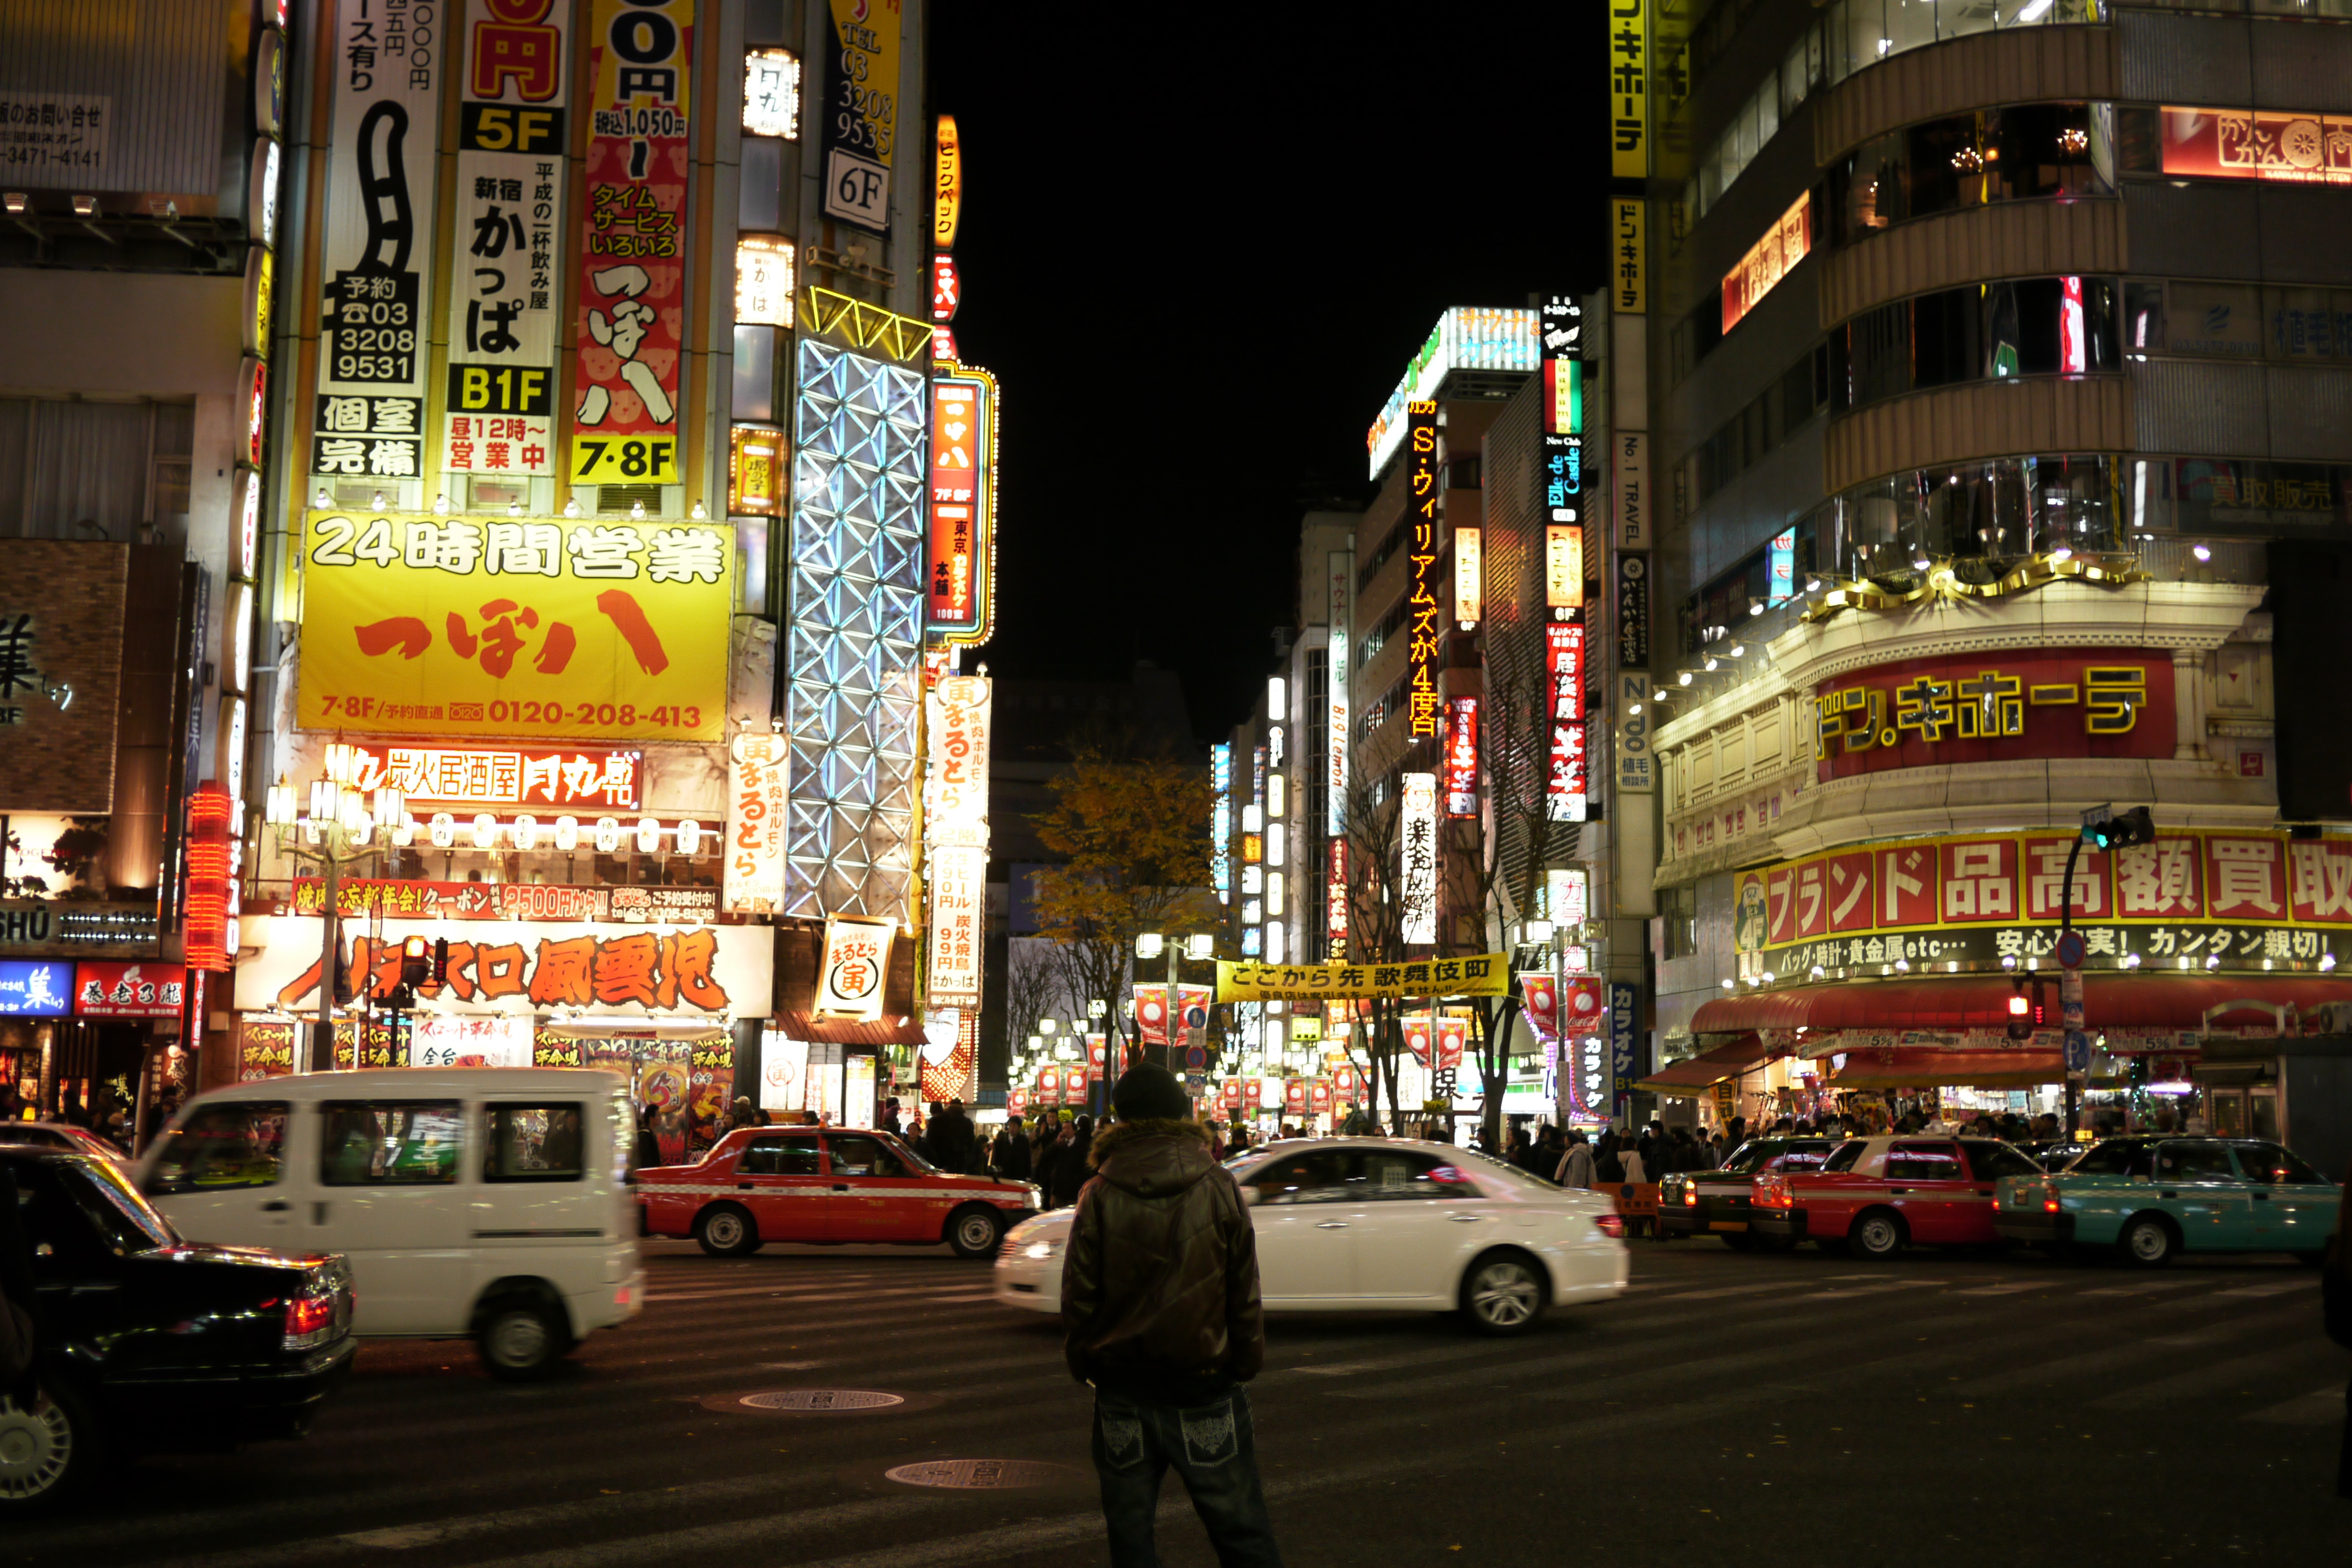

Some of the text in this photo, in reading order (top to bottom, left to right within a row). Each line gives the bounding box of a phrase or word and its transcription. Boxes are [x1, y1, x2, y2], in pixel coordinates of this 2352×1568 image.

[842, 23, 881, 53] TEL
[840, 48, 868, 81] 03
[838, 80, 892, 124] 3208
[475, 108, 553, 151] 5F
[594, 108, 685, 137] 税込1,050円
[837, 113, 892, 156] 9535
[475, 177, 522, 202] 新宿
[594, 185, 656, 209] タイム
[839, 168, 883, 210] 6F
[530, 162, 553, 309] 平成の一杯飲み屋
[593, 209, 679, 234] サービス
[591, 235, 677, 258] いろいろ
[343, 277, 397, 299] 予約
[371, 303, 409, 325] 03
[340, 329, 415, 352] 3208
[577, 264, 675, 426] つぼ八
[338, 357, 409, 381] 9531
[462, 368, 545, 411] B1F
[324, 397, 416, 433] 個室
[318, 439, 416, 476] 完備
[450, 443, 545, 470] 営業中
[1624, 481, 1640, 545] TRAVEL
[312, 516, 725, 585] 24時間営業
[354, 588, 670, 679] つぼ八
[488, 700, 701, 729] 0120-208-413
[941, 703, 969, 809] まるとら
[734, 762, 766, 877] まるとら
[764, 769, 783, 859] 焼肉ホルモン
[652, 891, 716, 906] ご予約受付中!
[832, 941, 879, 964] まるとら
[954, 914, 971, 970] 炭火焼鳥
[2149, 928, 2329, 958] カンタン親切!
[1232, 958, 1491, 989] ここから先 歌舞伎町
[1740, 951, 1763, 980] 買取
[1568, 1015, 1599, 1027] Coca-Cola
[1614, 989, 1632, 1073] カラオケ
[1584, 1038, 1603, 1108] カラオケ
